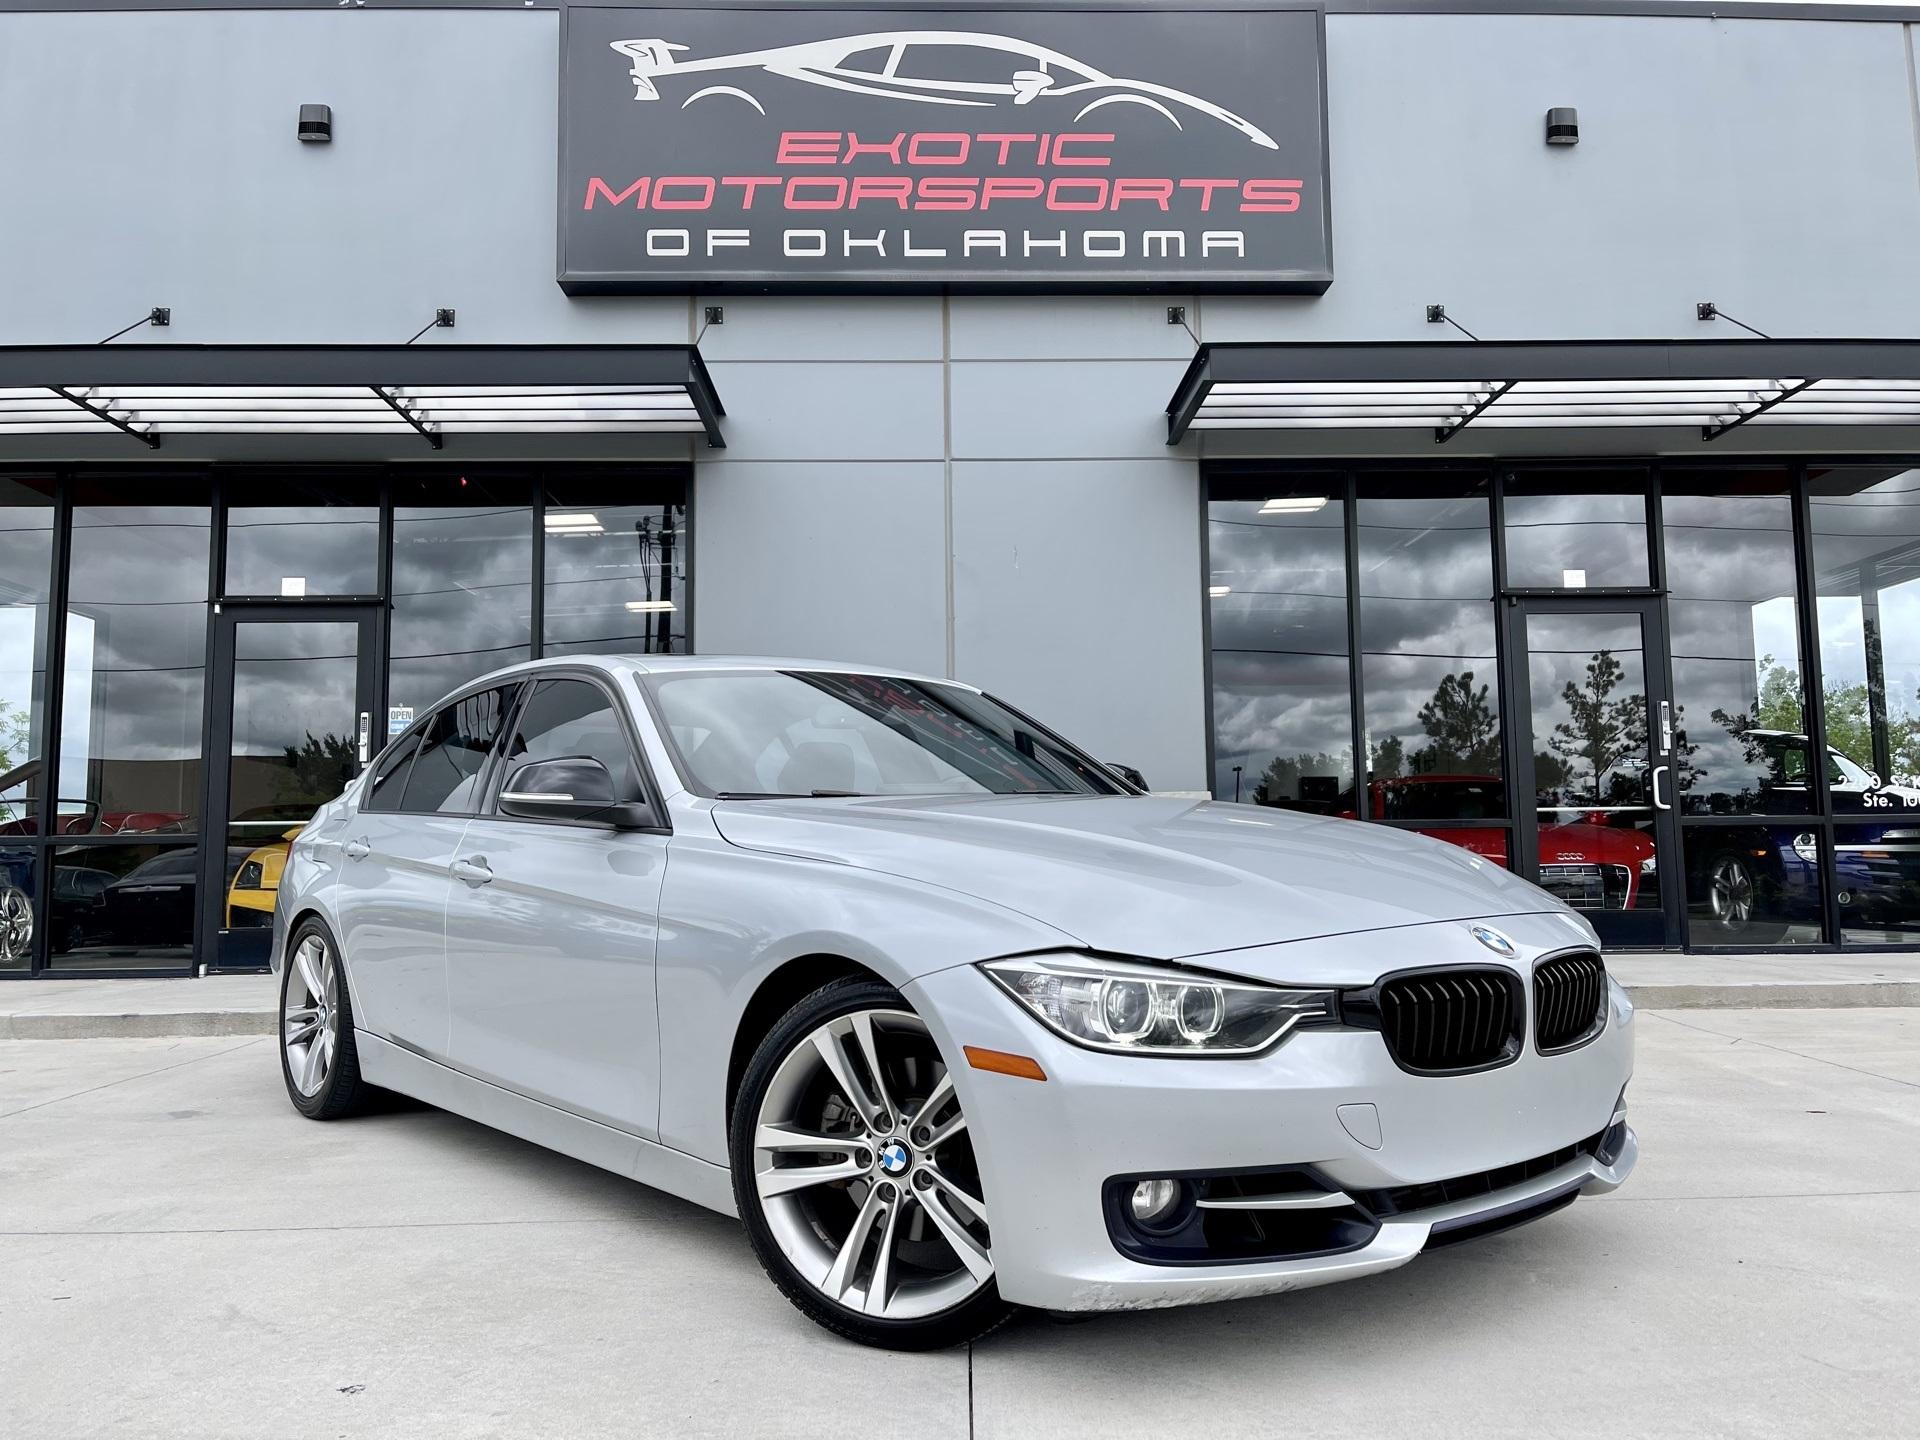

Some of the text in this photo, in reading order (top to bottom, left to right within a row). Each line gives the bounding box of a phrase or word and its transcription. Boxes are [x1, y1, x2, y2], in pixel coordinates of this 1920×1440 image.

[776, 131, 1114, 166] EXOTIC
[584, 176, 1303, 212] MOTORSPORTS
[646, 229, 1246, 258] OF OKLAHOMA
[390, 710, 412, 720] OPEN
[1837, 774, 1881, 789] 220
[1862, 792, 1893, 807] Ste.
